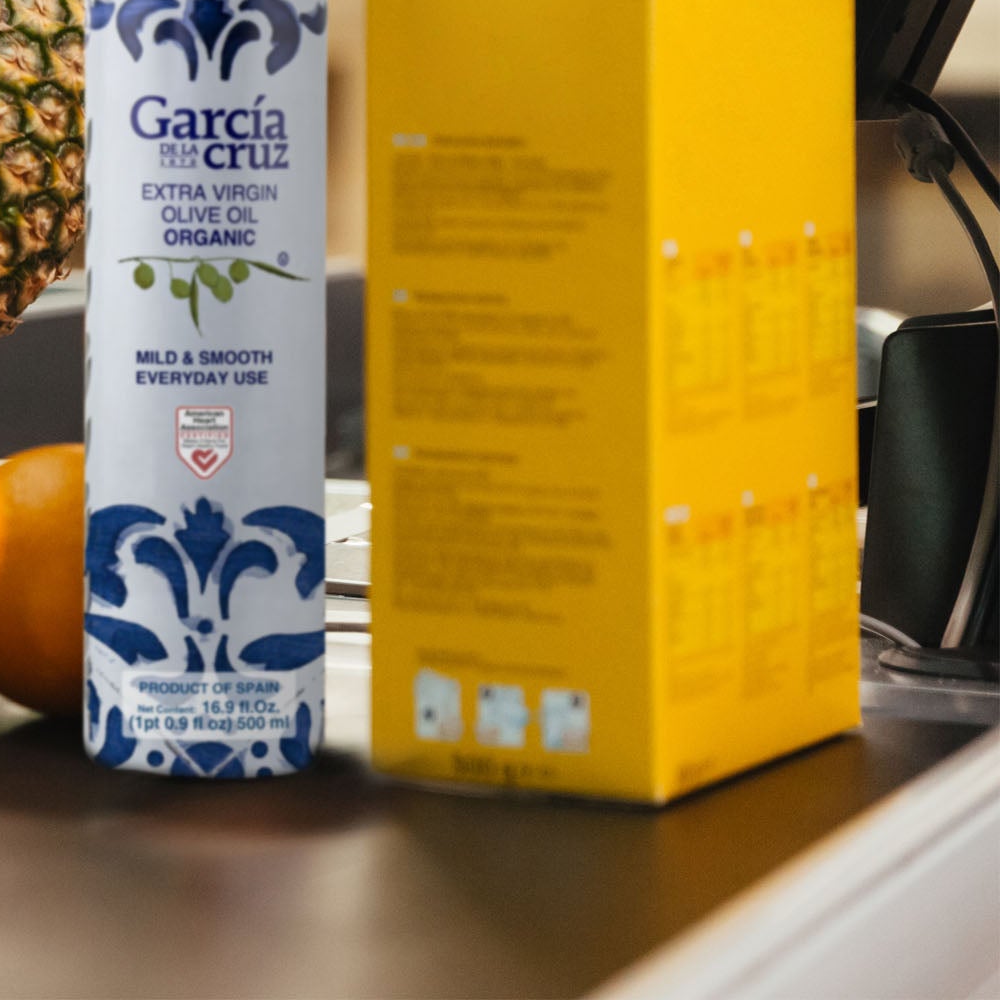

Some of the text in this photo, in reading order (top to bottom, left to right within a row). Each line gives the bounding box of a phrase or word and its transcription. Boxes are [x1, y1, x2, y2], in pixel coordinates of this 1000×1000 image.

[130, 94, 288, 140] García
[160, 143, 199, 155] DE LA
[203, 143, 289, 170] cruz
[141, 183, 278, 201] EXTRA VIRGIN
[161, 205, 258, 224] OLIVE OIL
[163, 228, 256, 246] ORGANIC
[136, 350, 273, 365] MILD & SMOOTH
[136, 370, 269, 385] EVERYDAY USE
[139, 681, 280, 694] PRODUCT OF SPAIN
[137, 704, 154, 713] Net
[203, 701, 234, 714] 16.9
[129, 716, 291, 732] (1pt 0.9 fl oz) 500 ml
